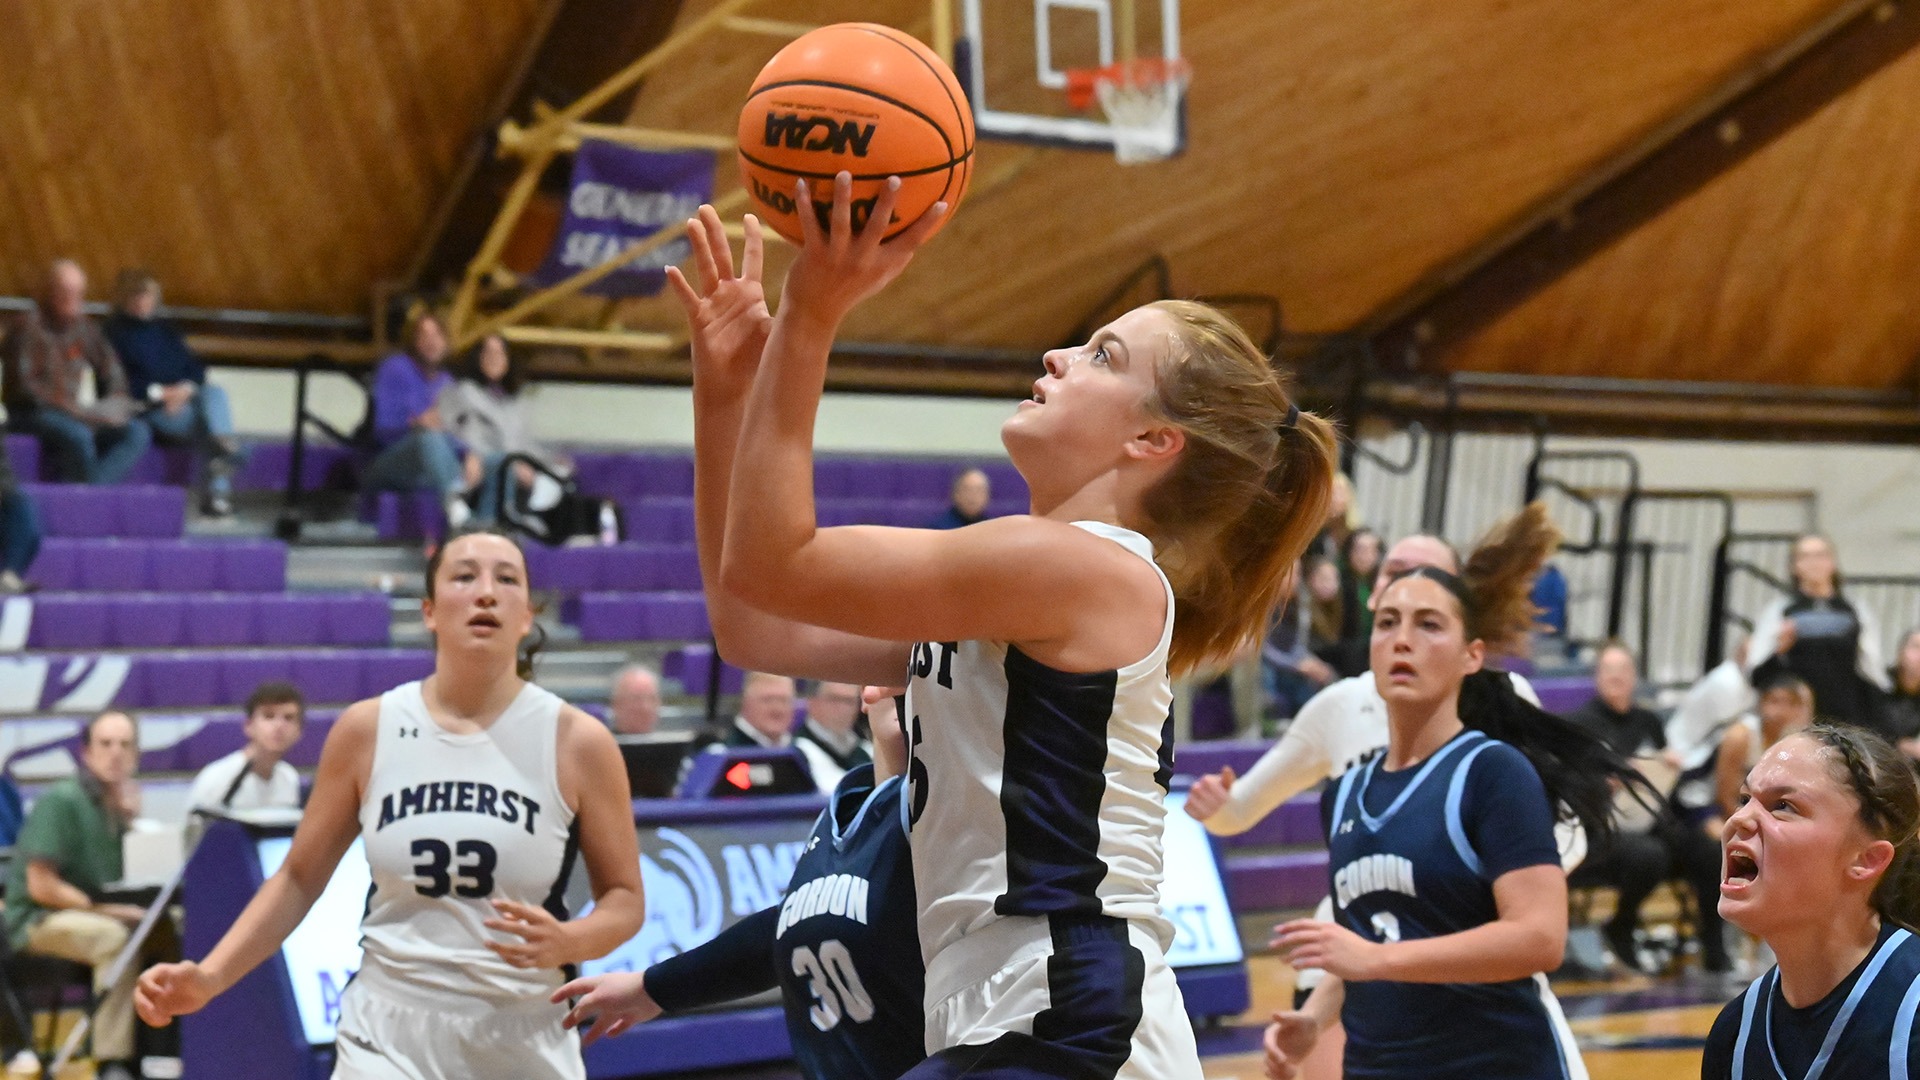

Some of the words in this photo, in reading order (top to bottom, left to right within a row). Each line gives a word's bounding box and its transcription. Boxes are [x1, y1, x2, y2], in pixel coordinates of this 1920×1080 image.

[765, 112, 877, 157] NCAA
[376, 781, 541, 836] AMHERST
[410, 839, 498, 899] 33
[1334, 853, 1418, 911] GORDON
[776, 873, 869, 940] GORDON
[791, 939, 875, 1032] 30
